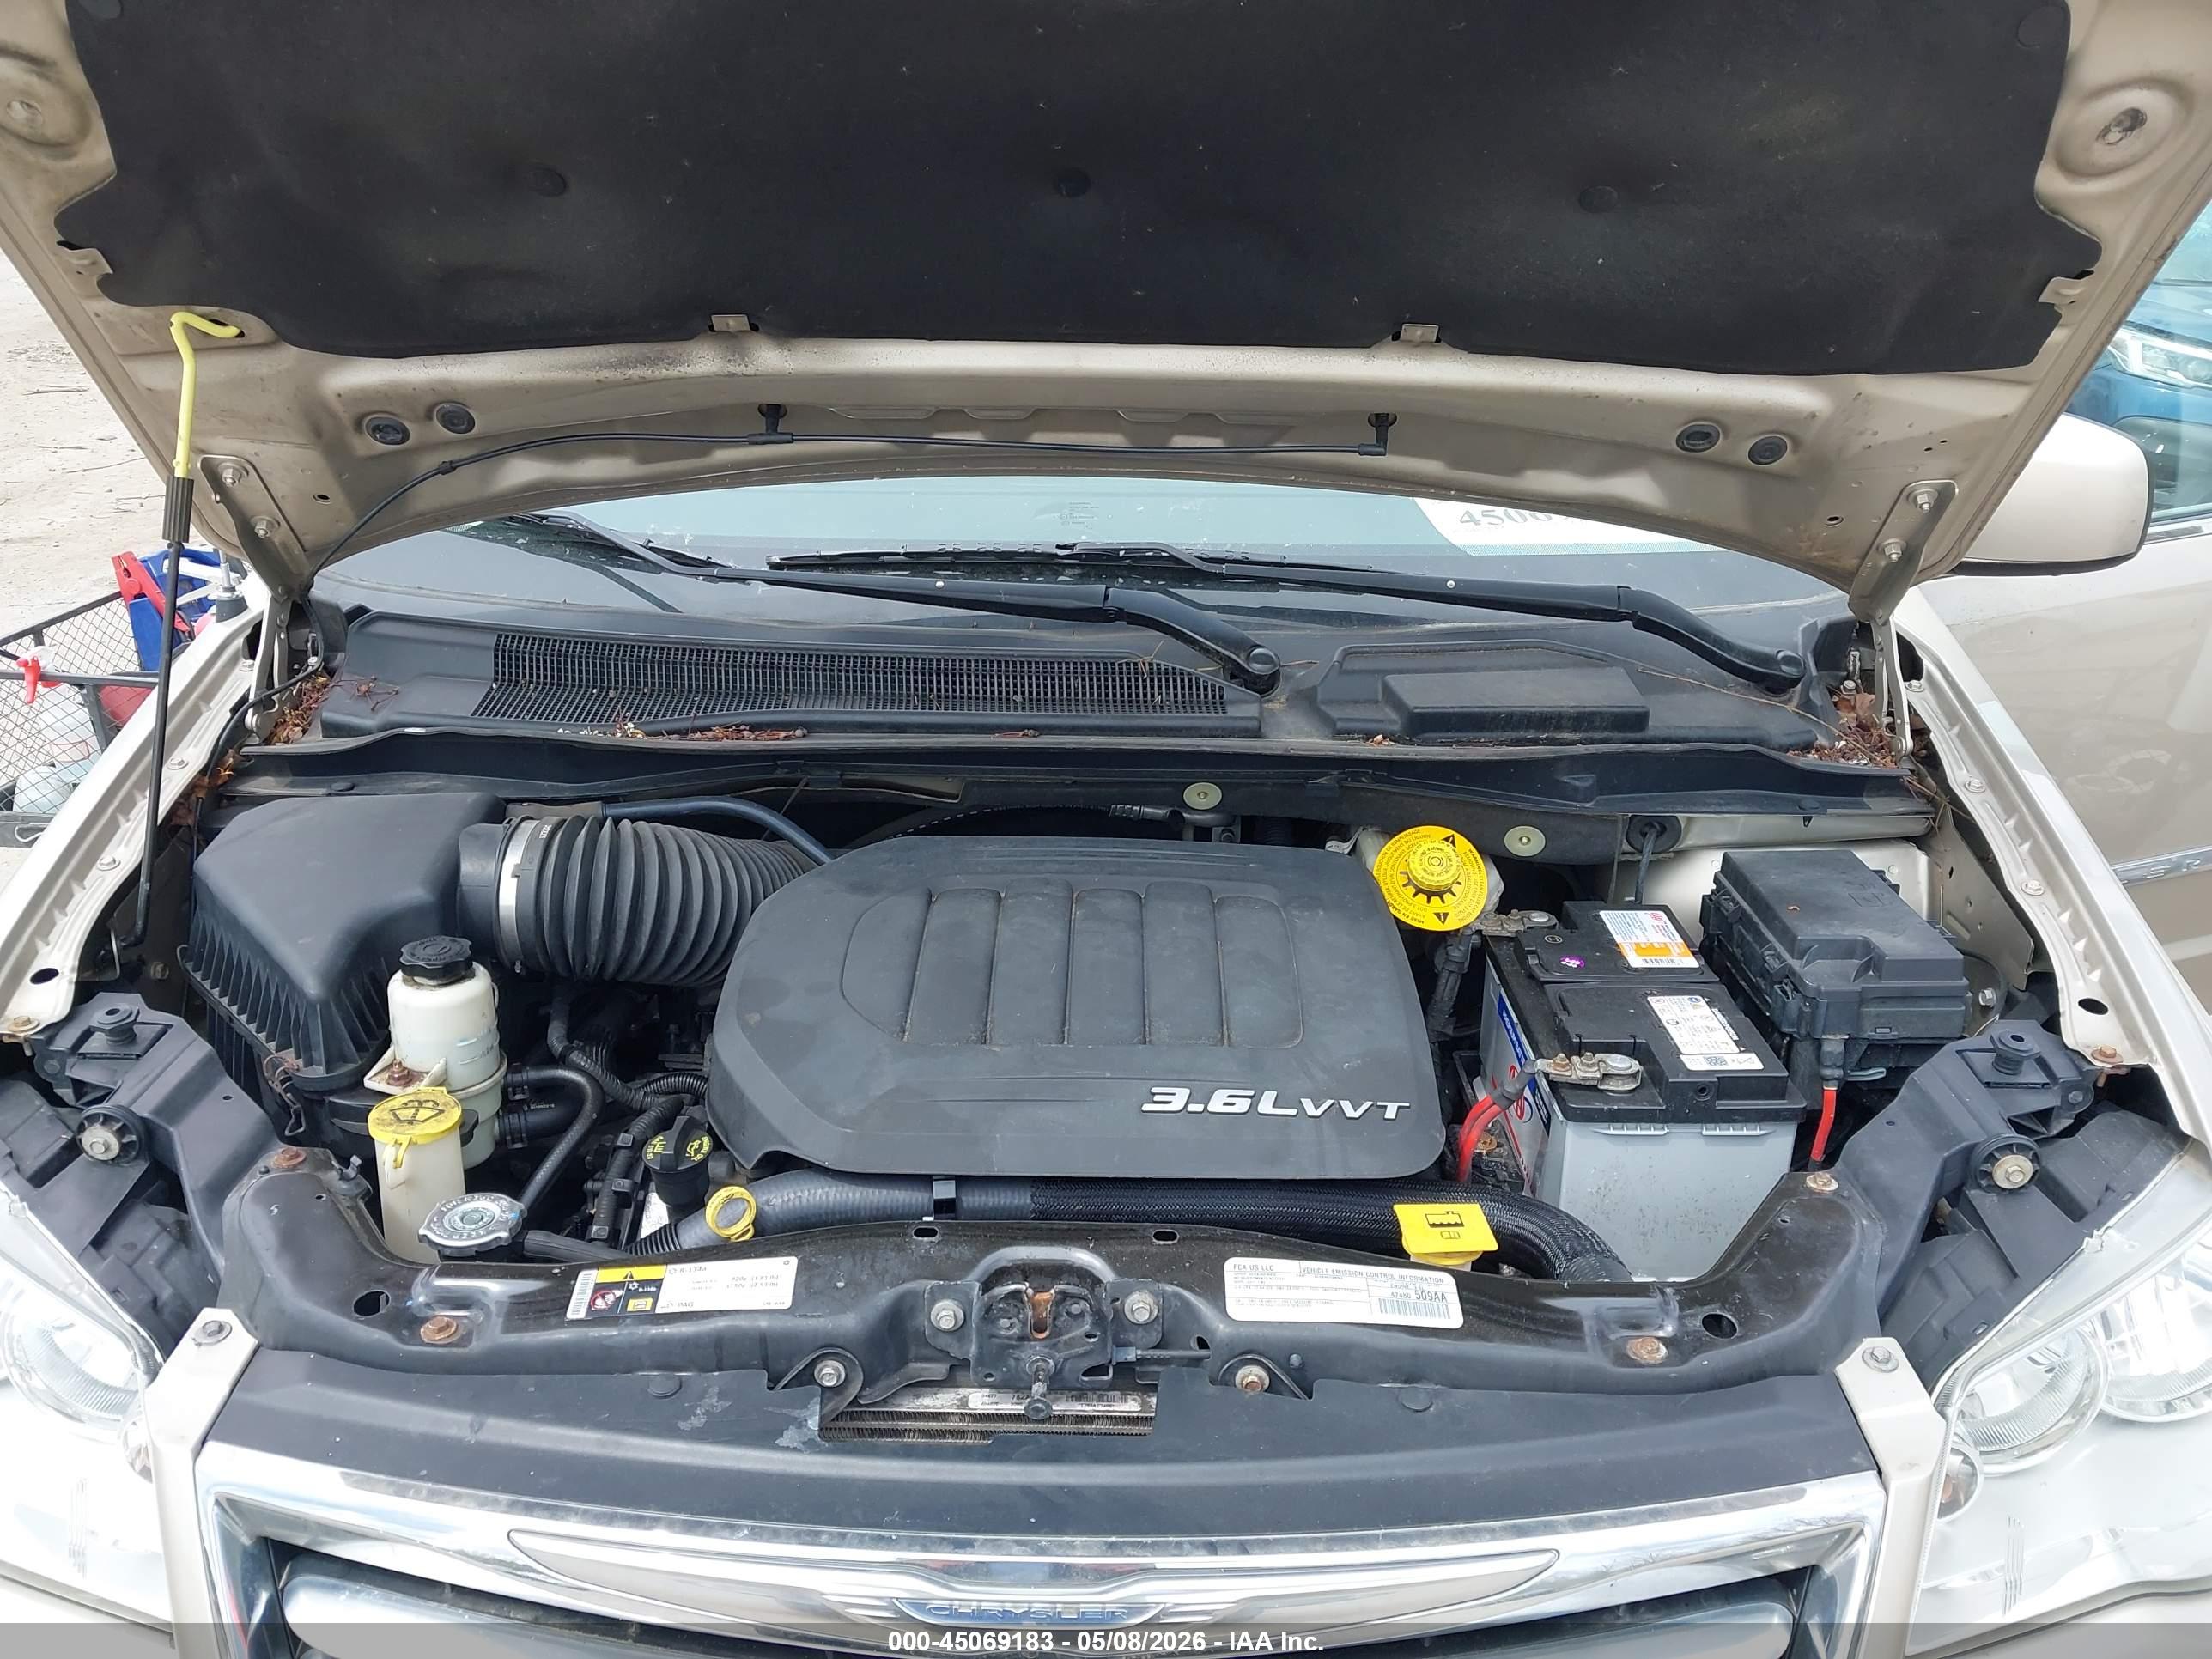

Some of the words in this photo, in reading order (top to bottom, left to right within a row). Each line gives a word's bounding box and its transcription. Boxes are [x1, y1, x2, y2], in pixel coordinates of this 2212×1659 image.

[1460, 508, 1570, 526] 450
[1141, 1086, 1298, 1118] 3.6L
[1300, 1098, 1411, 1121] VVT
[701, 1136, 710, 1153] ENGINE
[690, 1153, 703, 1162] OIL
[1303, 1267, 1329, 1275] VEHICLE
[1331, 1269, 1364, 1278] EMISSION
[1399, 1274, 1444, 1284] INFORMATION
[1414, 1290, 1449, 1303] 509AA
[926, 1602, 1127, 1620] CHRYSLER
